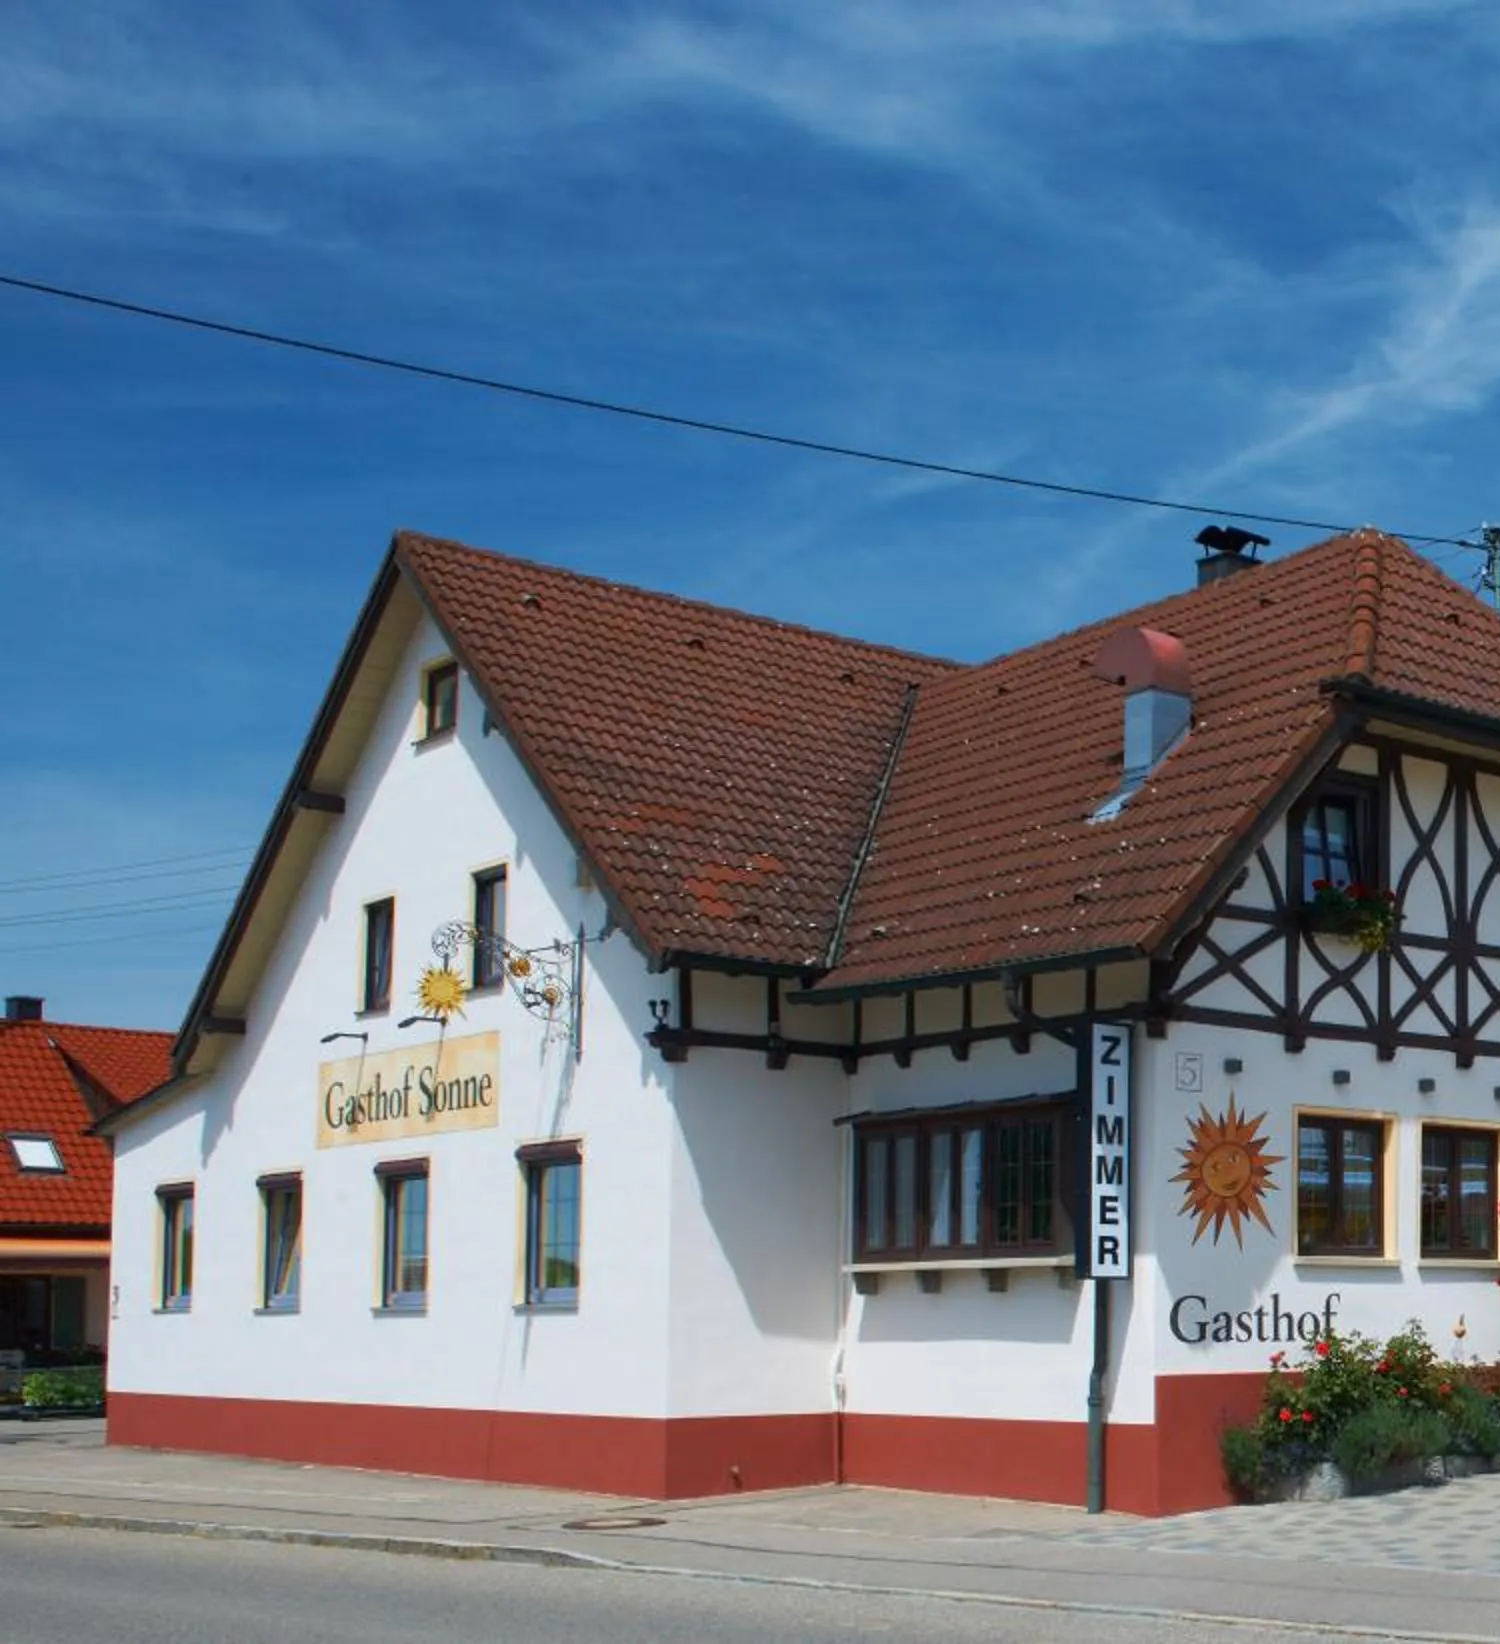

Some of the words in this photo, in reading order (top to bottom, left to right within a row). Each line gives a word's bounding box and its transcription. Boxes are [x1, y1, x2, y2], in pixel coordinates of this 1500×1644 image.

[325, 1065, 414, 1129] Gasthof
[419, 1066, 492, 1116] Sonne
[1181, 1057, 1198, 1087] 5
[1096, 1036, 1124, 1265] ZIMMER
[1169, 1293, 1341, 1344] Gasthof
